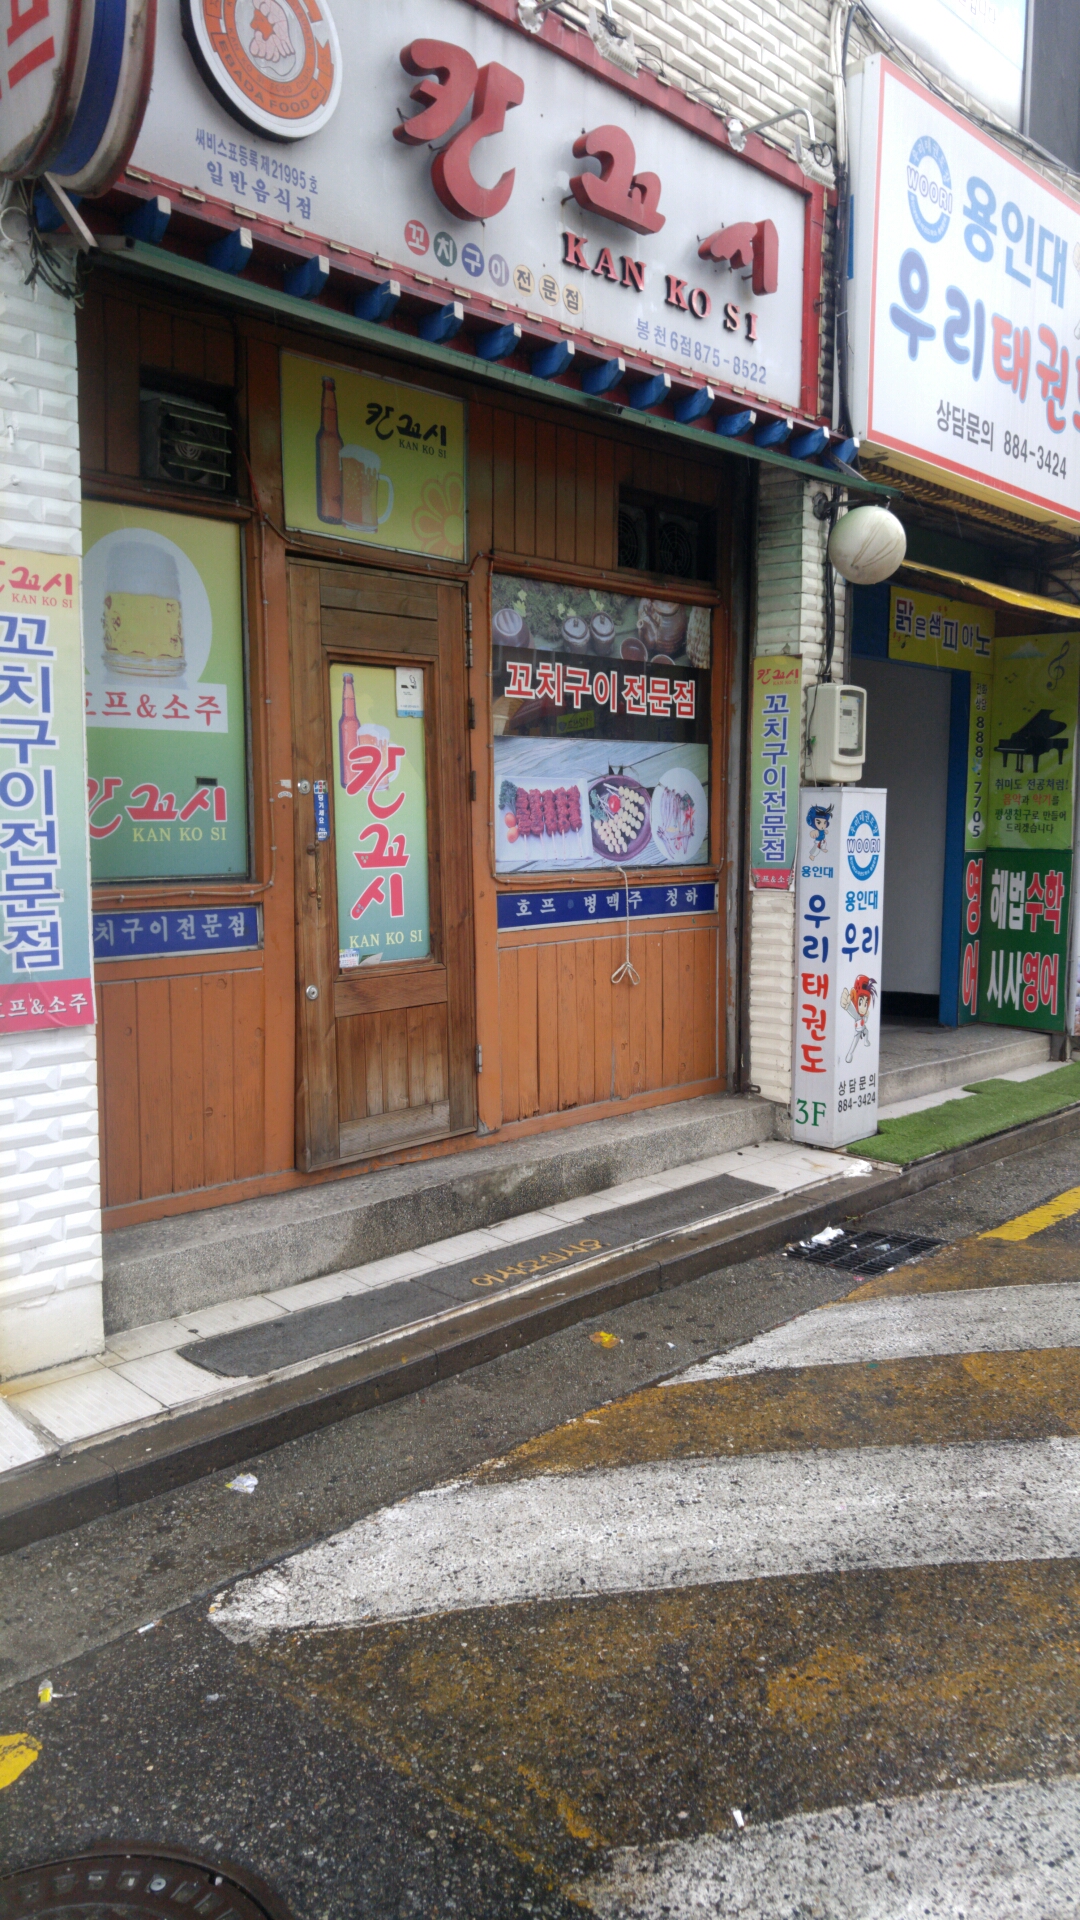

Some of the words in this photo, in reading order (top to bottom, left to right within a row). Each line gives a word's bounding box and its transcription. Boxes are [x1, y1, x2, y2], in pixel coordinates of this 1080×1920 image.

[218, 39, 265, 103] EBADA
[269, 99, 310, 113] FOOD
[206, 160, 312, 219] 일반음식점
[906, 165, 953, 214] WOORI
[962, 176, 1068, 308] 용인대
[562, 231, 647, 292] KAN
[665, 273, 712, 319] KO
[723, 302, 759, 342] SI
[398, 438, 418, 450] KAN
[422, 443, 435, 456] KO
[438, 449, 447, 459] SI
[936, 399, 994, 452] 상담문의
[1003, 430, 1067, 480] 884-3424
[11, 592, 37, 605] KAN
[42, 595, 58, 607] KO
[62, 598, 73, 609] SI
[762, 693, 790, 863] 꼬치구이전문점
[995, 778, 1023, 791] 취미도
[1027, 778, 1069, 791] 전공처럼!
[1003, 793, 1030, 806] 음악과
[1032, 793, 1060, 806] 악기를
[995, 808, 1040, 821] 평생친구로
[1043, 810, 1067, 821] 만들어
[132, 827, 171, 842] KAN
[179, 826, 203, 841] KO
[210, 826, 227, 841] SI
[1005, 822, 1054, 835] 드리겠습니다
[846, 838, 880, 854] WOORI
[801, 865, 834, 879] 용인대
[516, 898, 557, 918] 호프
[584, 890, 644, 914] 병맥주
[666, 886, 699, 908] 청하
[845, 890, 879, 913] 용인대
[990, 867, 1065, 935] 해법수학
[349, 932, 380, 948] KAN
[386, 931, 405, 946] KO
[410, 929, 423, 943] SI
[841, 922, 880, 963] 우리
[962, 857, 984, 1016] 영어
[986, 949, 1060, 1016] 시사영어
[837, 1073, 876, 1097] 상담문의
[795, 1098, 827, 1127] 3F
[837, 1092, 876, 1114] 884-3424
